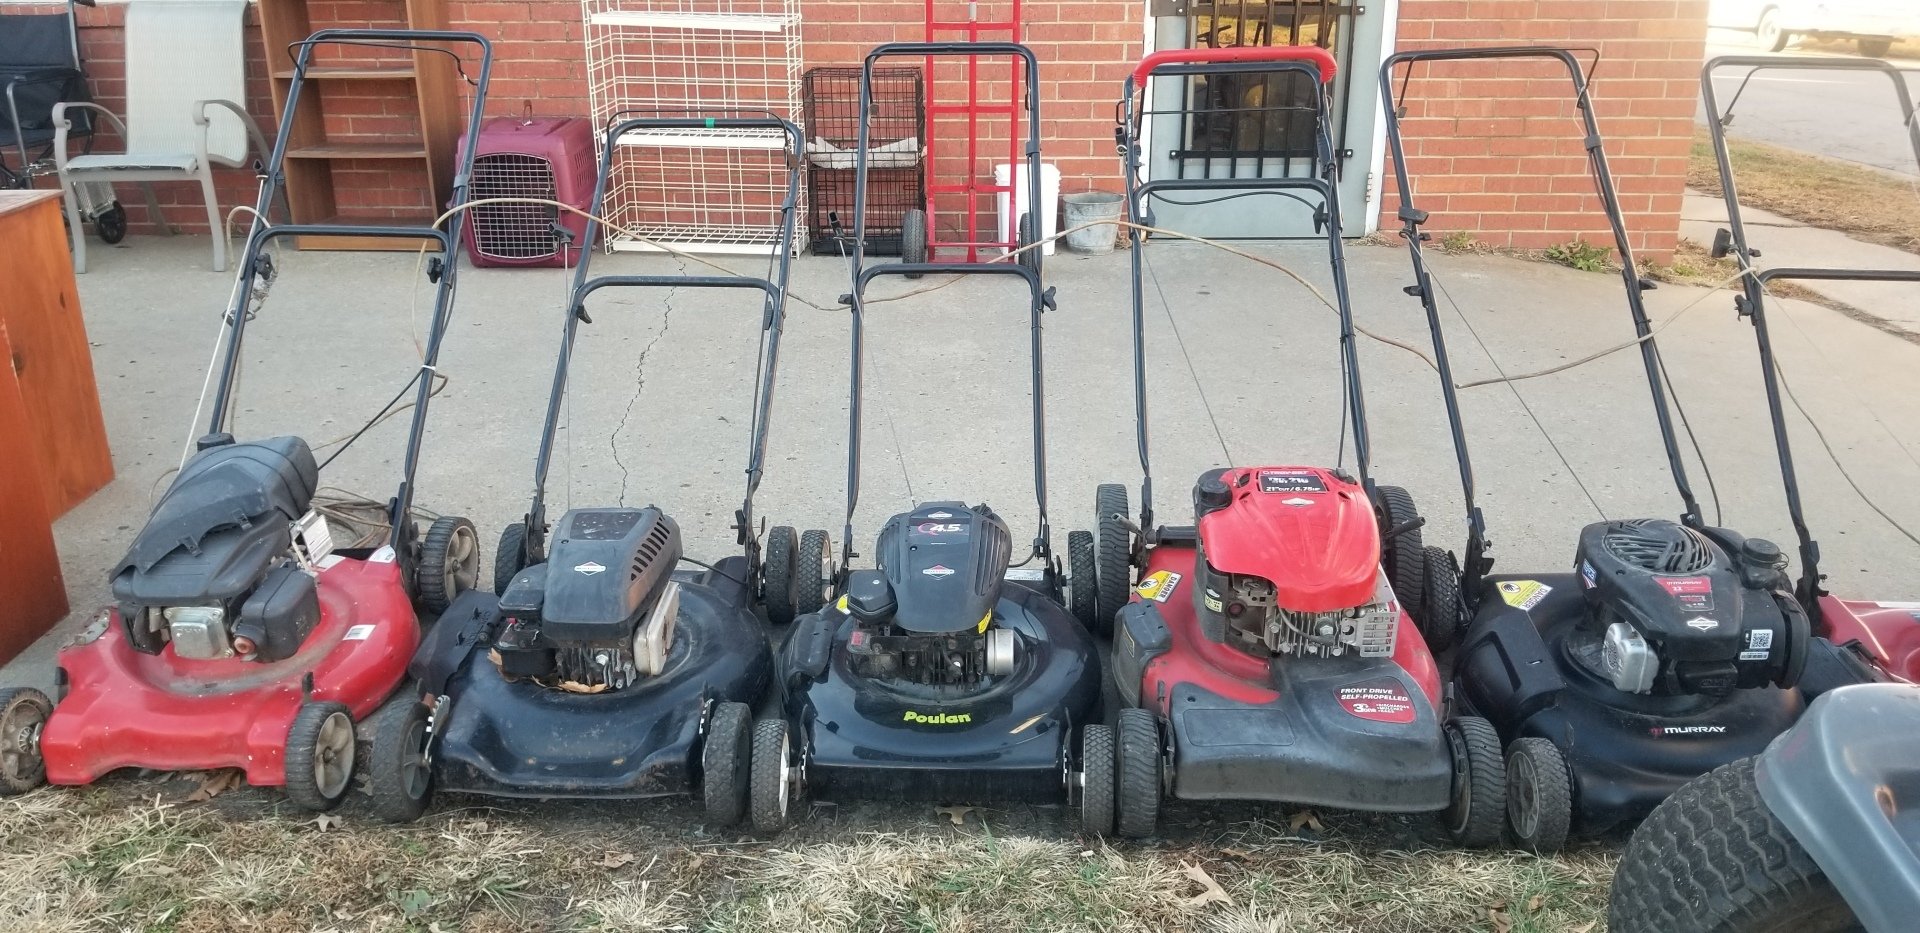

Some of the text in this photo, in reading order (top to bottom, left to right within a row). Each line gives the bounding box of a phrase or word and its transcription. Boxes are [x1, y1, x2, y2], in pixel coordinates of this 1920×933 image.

[1159, 576, 1178, 598] DANGER
[1341, 694, 1408, 702] SELF-PROPELLED
[903, 711, 971, 724] Poulan
[1664, 726, 1726, 734] MURRAY
